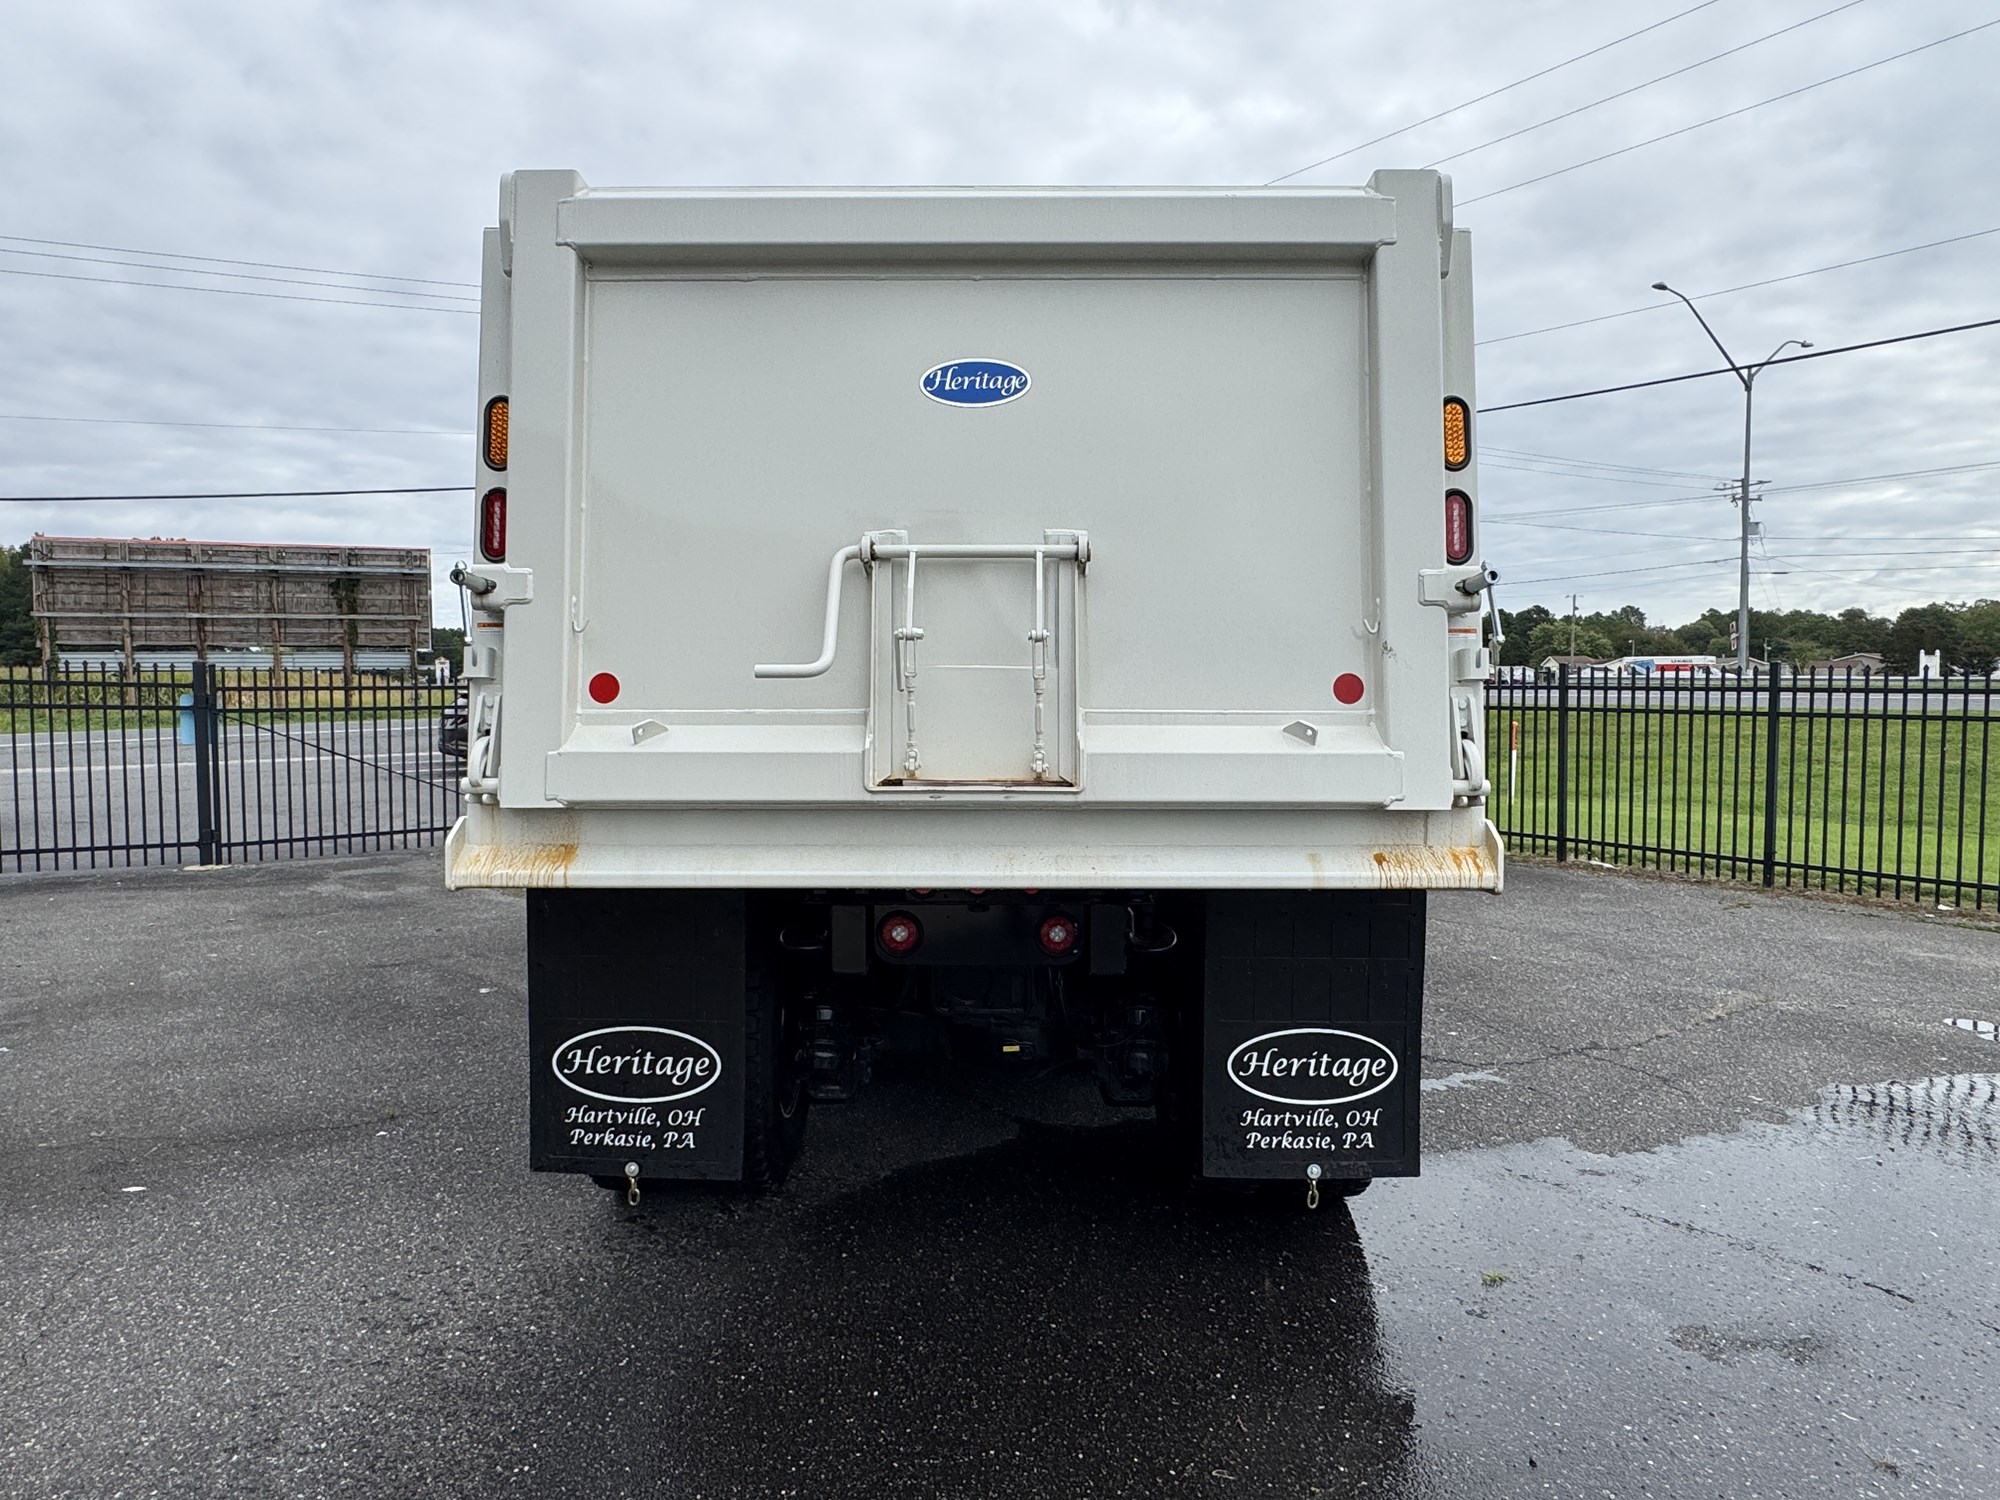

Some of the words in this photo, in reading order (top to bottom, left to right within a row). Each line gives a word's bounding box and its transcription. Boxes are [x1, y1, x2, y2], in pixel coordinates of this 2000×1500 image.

[926, 366, 1025, 396] Heritage
[564, 1046, 710, 1086] Heritage
[1238, 1047, 1387, 1087] Heritage
[564, 1105, 661, 1128] Hartville,
[667, 1107, 706, 1127] OH
[1240, 1107, 1339, 1129] Hartville,
[1345, 1107, 1383, 1127] OH
[570, 1127, 657, 1150] Perkasie,
[663, 1131, 696, 1149] PA
[1246, 1130, 1336, 1151] Perkasie,
[1342, 1131, 1375, 1149] PA
